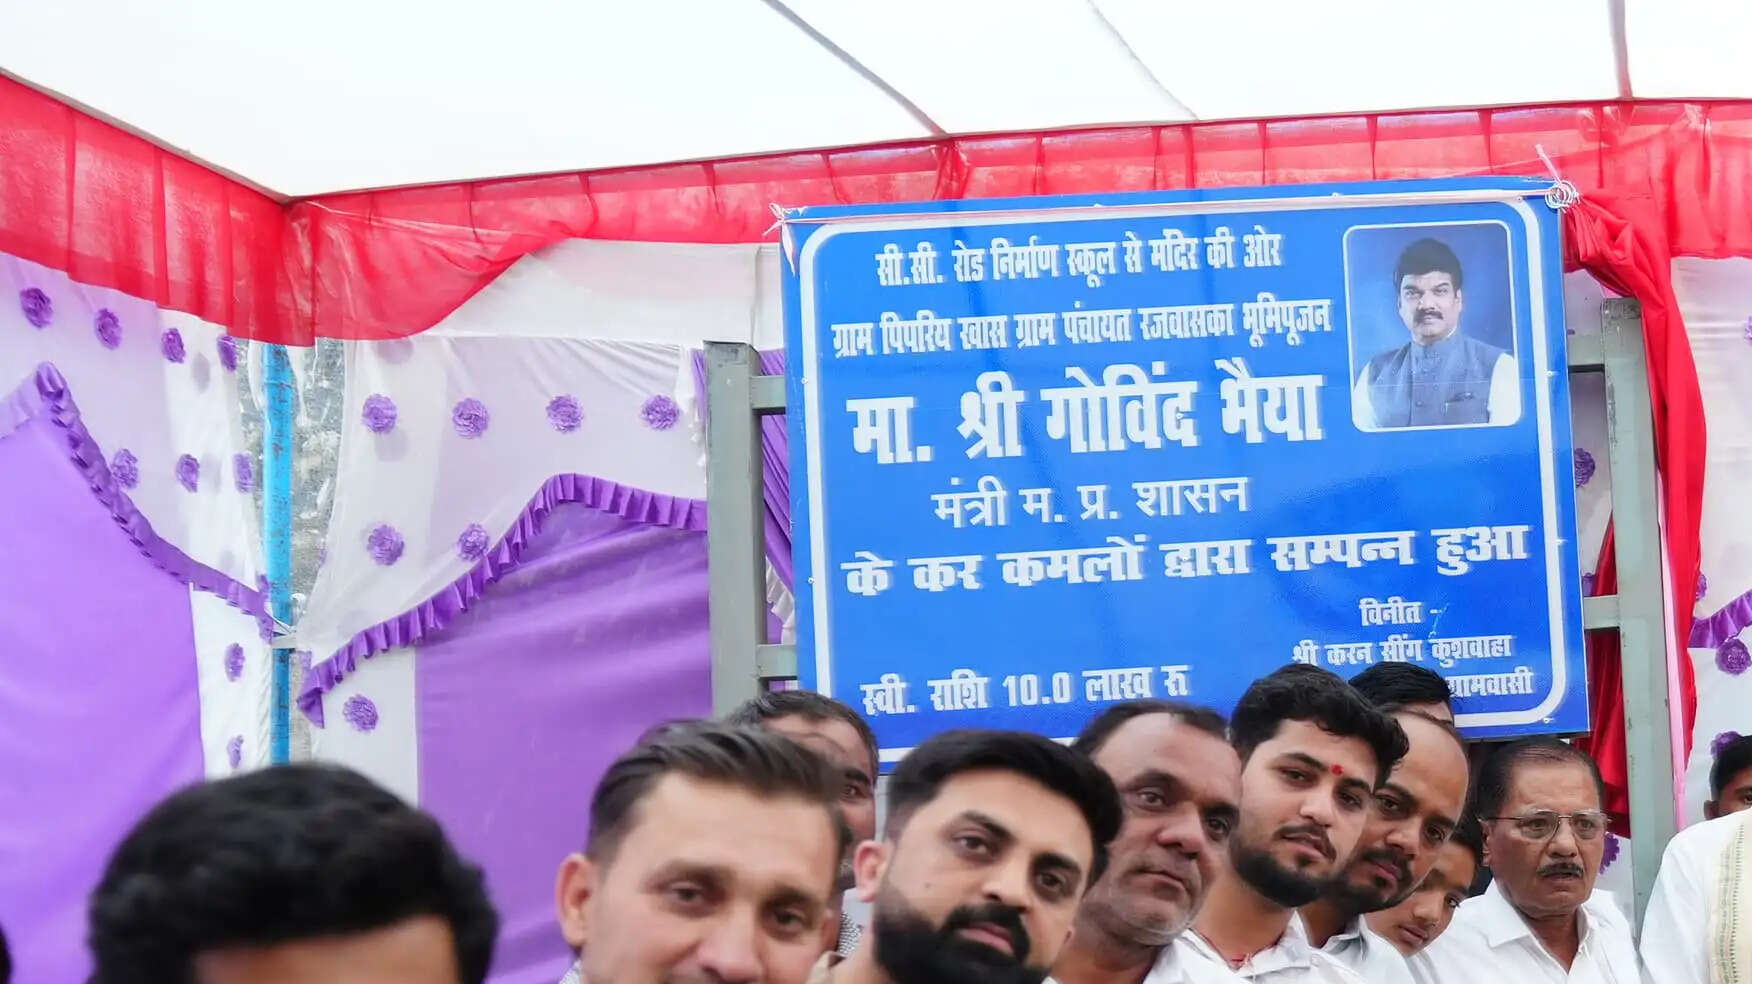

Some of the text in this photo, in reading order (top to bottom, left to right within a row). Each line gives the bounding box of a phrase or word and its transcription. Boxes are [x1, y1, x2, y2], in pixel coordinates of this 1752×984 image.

[951, 240, 986, 282] रोड
[989, 235, 1060, 280] निर्माण
[1065, 241, 1117, 288] स्कूल
[1122, 231, 1143, 273] से
[1204, 226, 1236, 269] की
[1243, 225, 1282, 267] ओर
[831, 322, 874, 358] ग्राम
[1013, 312, 1057, 348] ग्राम
[1061, 301, 1133, 344] पंचायत
[1242, 292, 1332, 348] भूमिपूजन
[846, 357, 1323, 464] मा. श्री गोविंद भैया
[931, 475, 1249, 528] मंत्री म. प्र. शासन
[841, 525, 1529, 596] के कर कमलों द्वारा सम्पन्न हुआ
[1359, 596, 1422, 626] विनीत
[1293, 634, 1512, 668] श्री करन सींग कुशवाहा
[860, 673, 915, 715] स्वी.
[927, 668, 989, 711] राशि
[1003, 672, 1071, 707] 10.0
[1082, 667, 1153, 701] लाख
